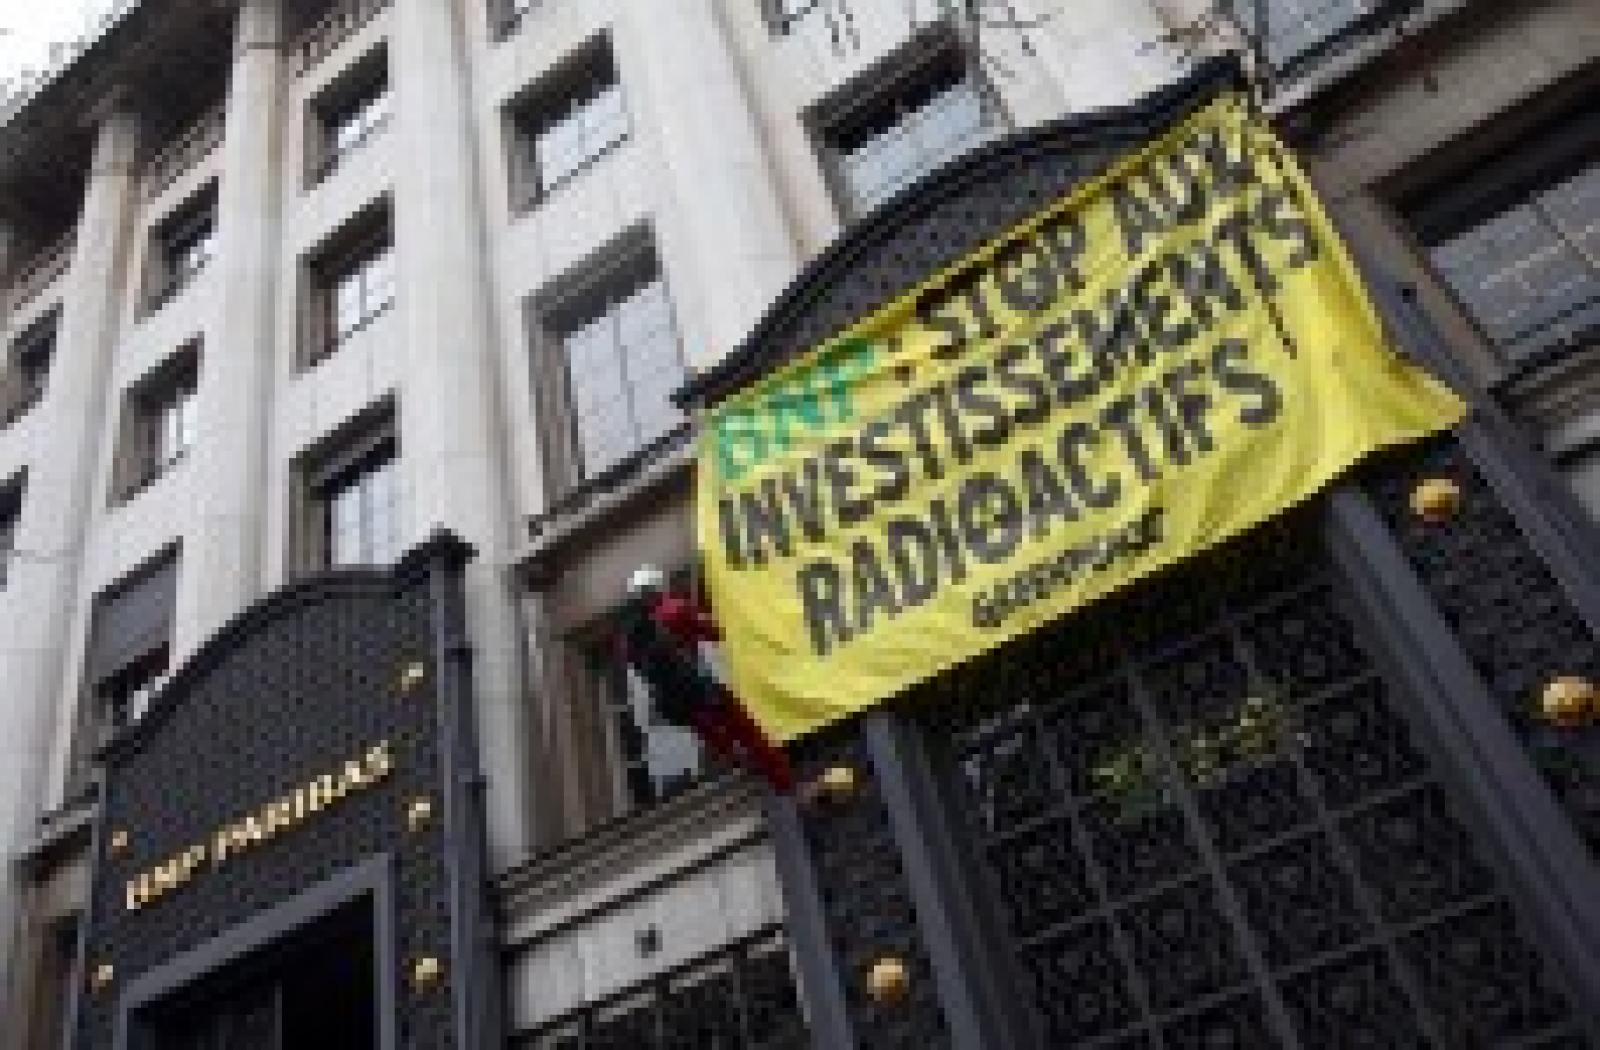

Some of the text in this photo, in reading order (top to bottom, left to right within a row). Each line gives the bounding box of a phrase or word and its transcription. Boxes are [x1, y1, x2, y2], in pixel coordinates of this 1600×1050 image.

[716, 338, 878, 481] BNP
[916, 212, 1088, 358] STOP
[1110, 128, 1256, 256] AUX
[719, 192, 1322, 569] INVESTISSEMENTS
[798, 338, 1281, 657] RADIOACTIFS
